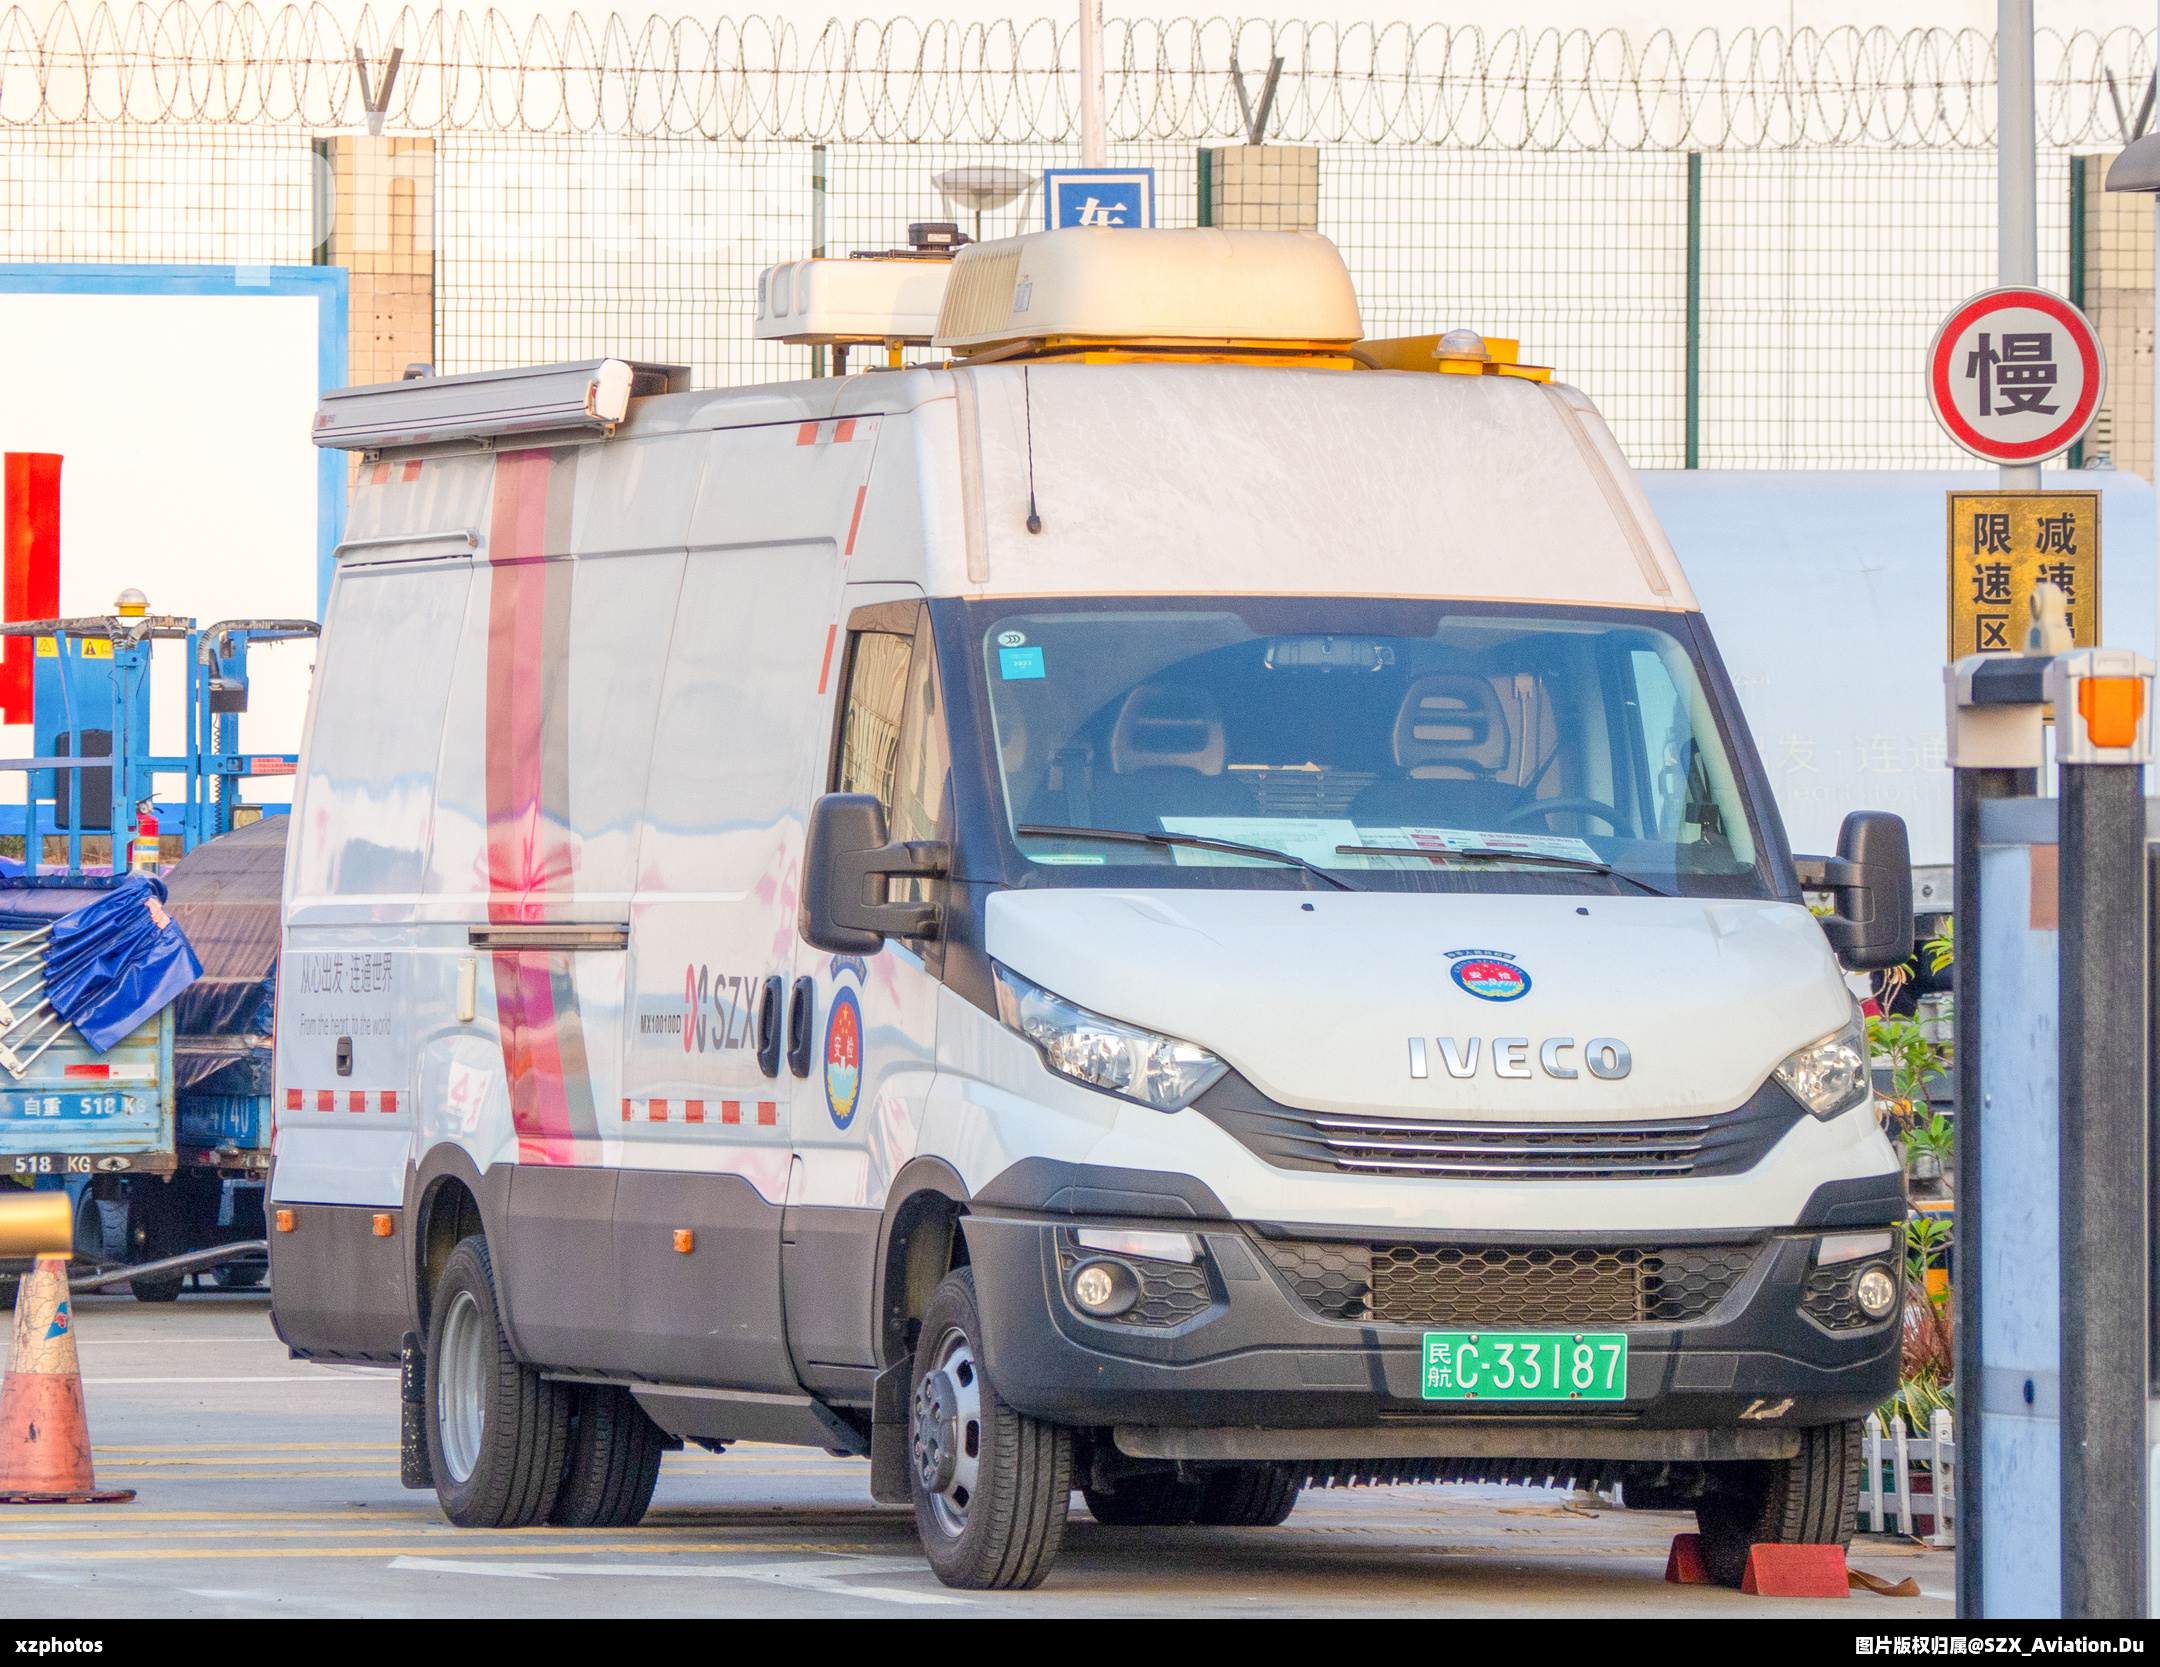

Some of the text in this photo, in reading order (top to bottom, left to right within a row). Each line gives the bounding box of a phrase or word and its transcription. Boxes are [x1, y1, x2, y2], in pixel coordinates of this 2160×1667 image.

[1966, 333, 2060, 416] 慢
[1972, 513, 2013, 653] 限速区
[2036, 512, 2077, 642] 减速
[300, 1012, 316, 1036] From
[318, 1012, 329, 1035] the
[360, 1012, 371, 1035] the
[373, 1012, 391, 1035] world
[640, 973, 759, 1051] MX100100D SZX
[1408, 1037, 1632, 1079] IVECO
[24, 1097, 147, 1117] 自重 518 KG
[15, 1155, 91, 1173] 518 KG
[1427, 1343, 1622, 1389] 民航 C-33187
